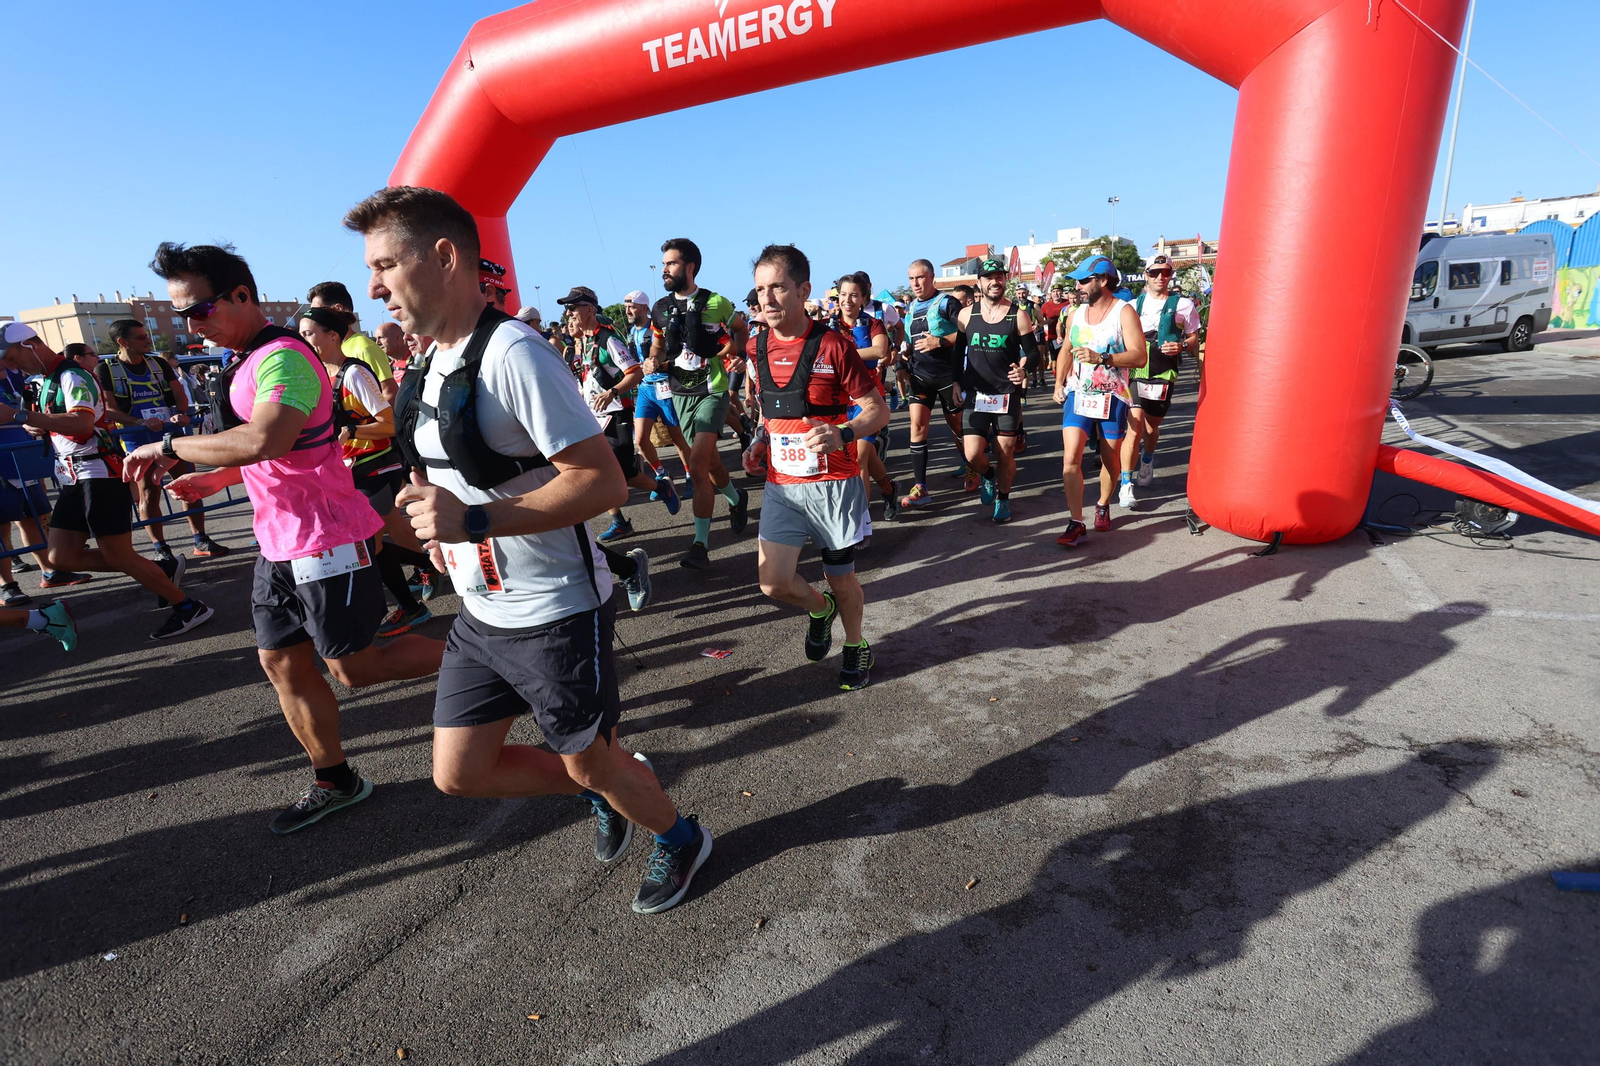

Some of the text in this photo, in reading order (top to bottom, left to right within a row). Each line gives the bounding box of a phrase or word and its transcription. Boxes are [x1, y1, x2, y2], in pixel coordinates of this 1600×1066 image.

[642, 0, 837, 73] TEAMERGY
[1126, 273, 1145, 282] TRAI
[1081, 399, 1098, 409] 132
[780, 448, 807, 462] 388
